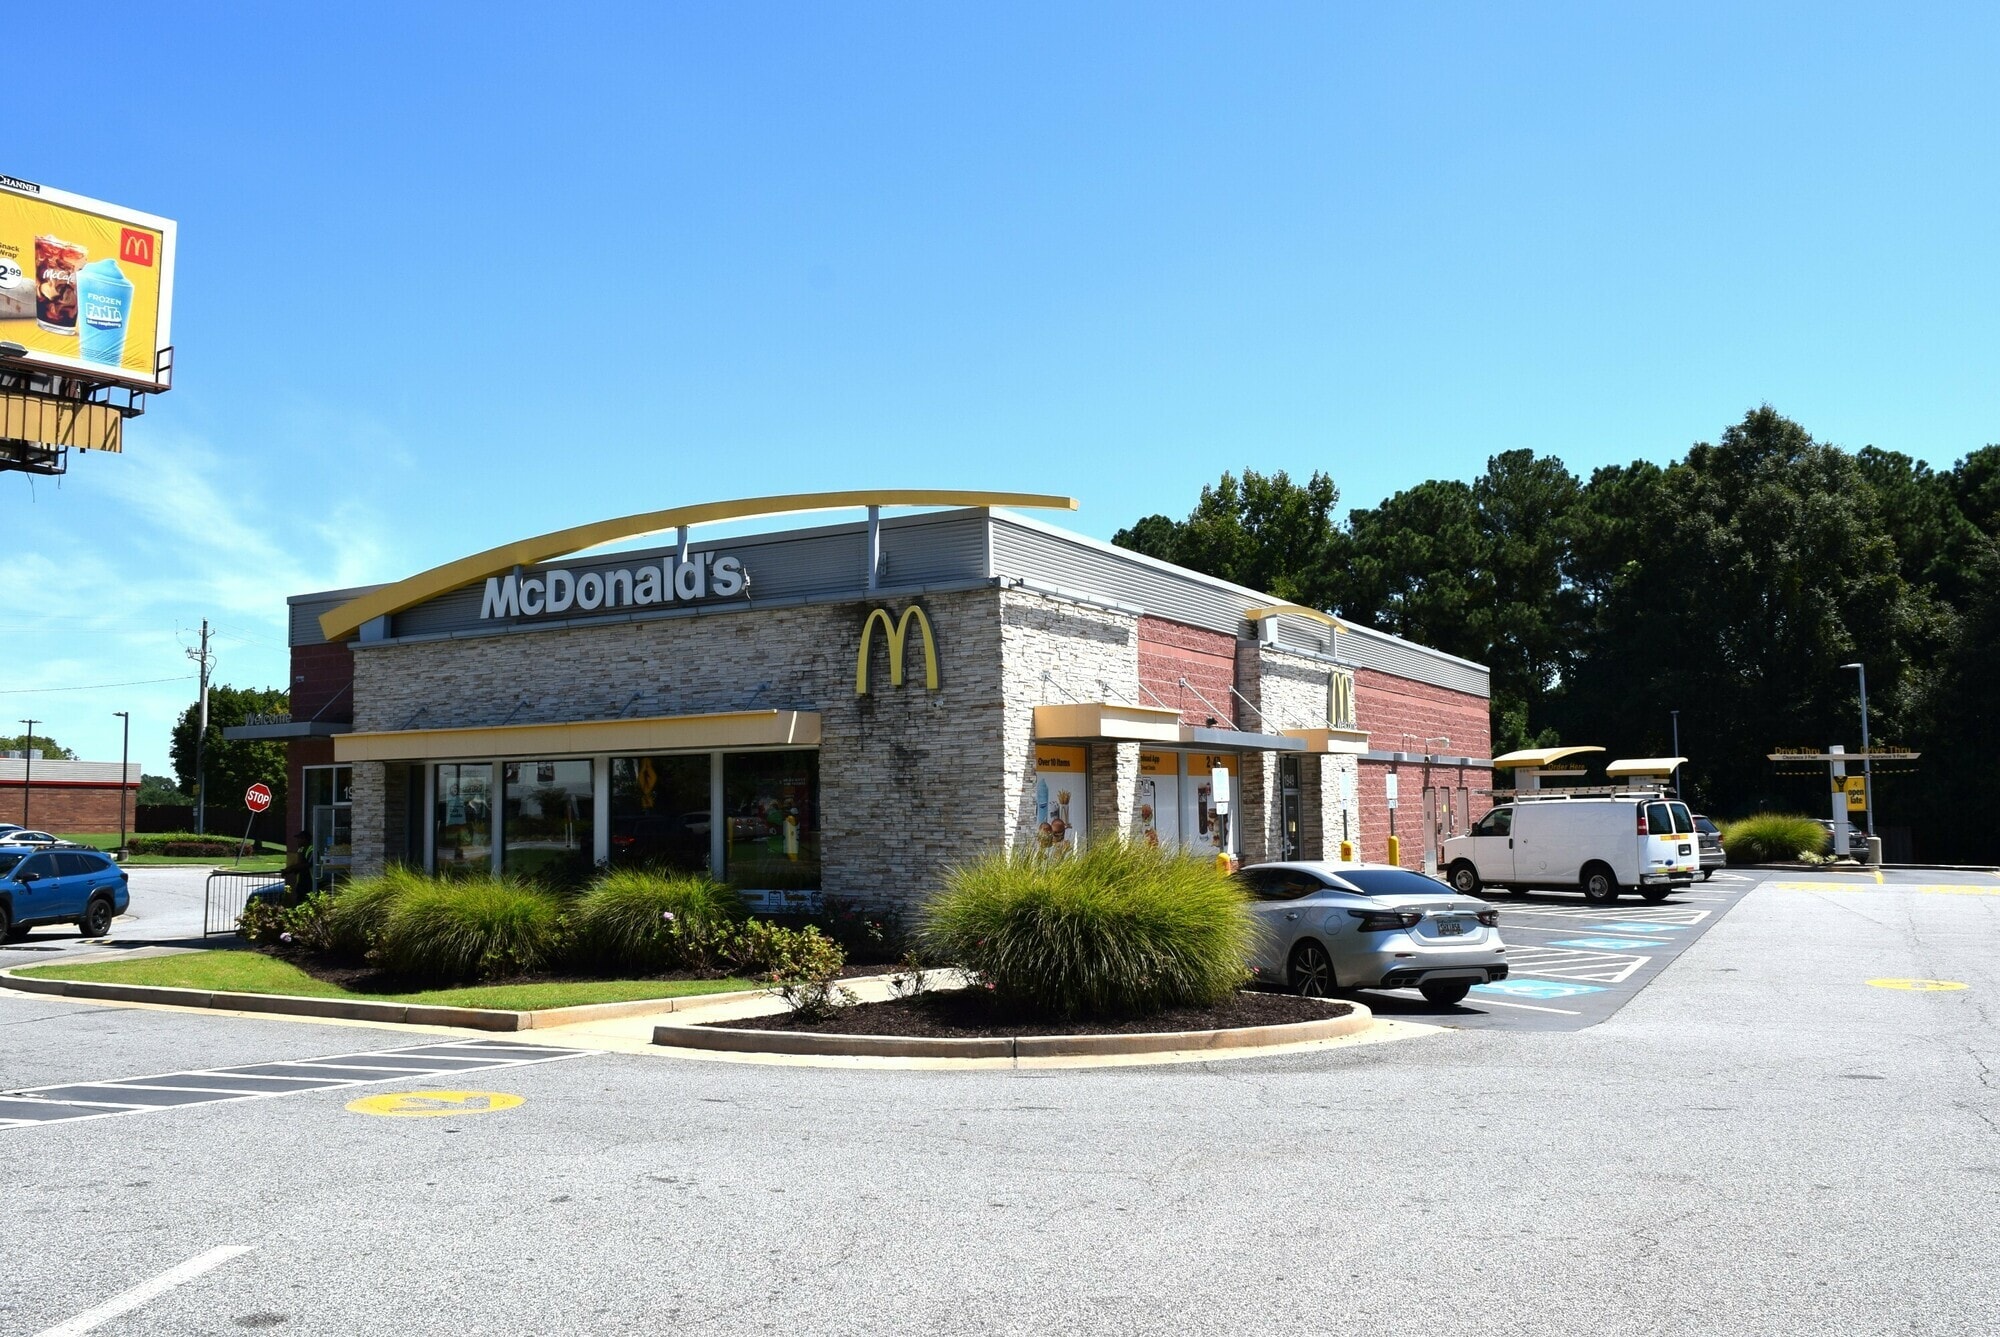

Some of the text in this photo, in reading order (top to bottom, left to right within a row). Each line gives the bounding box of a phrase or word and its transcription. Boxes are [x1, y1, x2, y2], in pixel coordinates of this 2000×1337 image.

[87, 292, 122, 306] FROZEN
[86, 303, 122, 321] FANTA
[480, 551, 743, 619] McDonald's
[245, 712, 293, 726] Welcome
[1775, 746, 1820, 755] Drive Thru
[1860, 745, 1911, 754] Drive Thru
[247, 790, 270, 805] STOP
[1848, 789, 1864, 797] open
[1850, 796, 1863, 804] late
